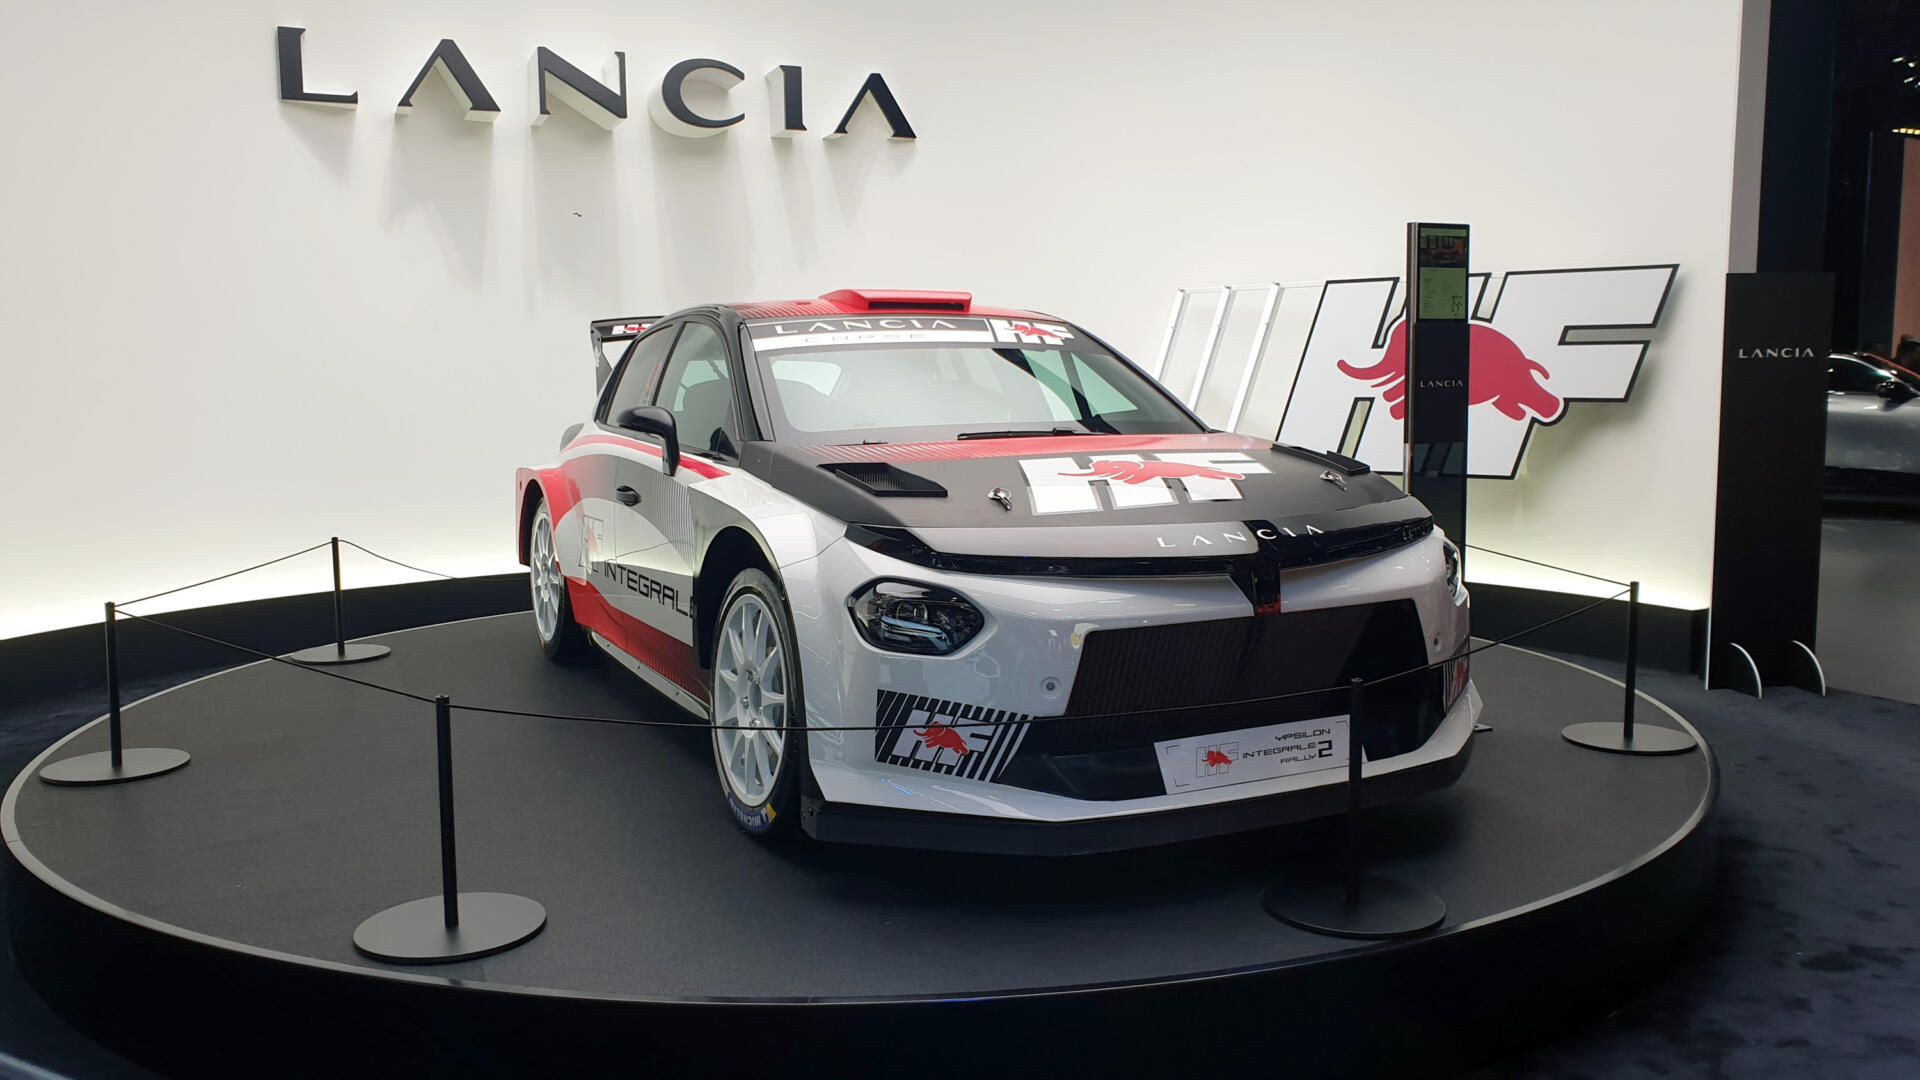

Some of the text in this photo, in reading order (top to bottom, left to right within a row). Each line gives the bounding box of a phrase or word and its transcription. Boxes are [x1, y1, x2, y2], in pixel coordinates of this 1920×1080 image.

[276, 26, 918, 139] LANCIA
[774, 318, 958, 335] LANCIA
[1739, 347, 1815, 359] LANCIA
[1419, 379, 1464, 388] LANCIA
[1018, 452, 1273, 515] HF
[1156, 524, 1325, 549] LANCIA
[1274, 728, 1331, 742] YPSILON
[1242, 740, 1333, 759] INTEGRALE 2
[1280, 753, 1317, 765] RALLY
